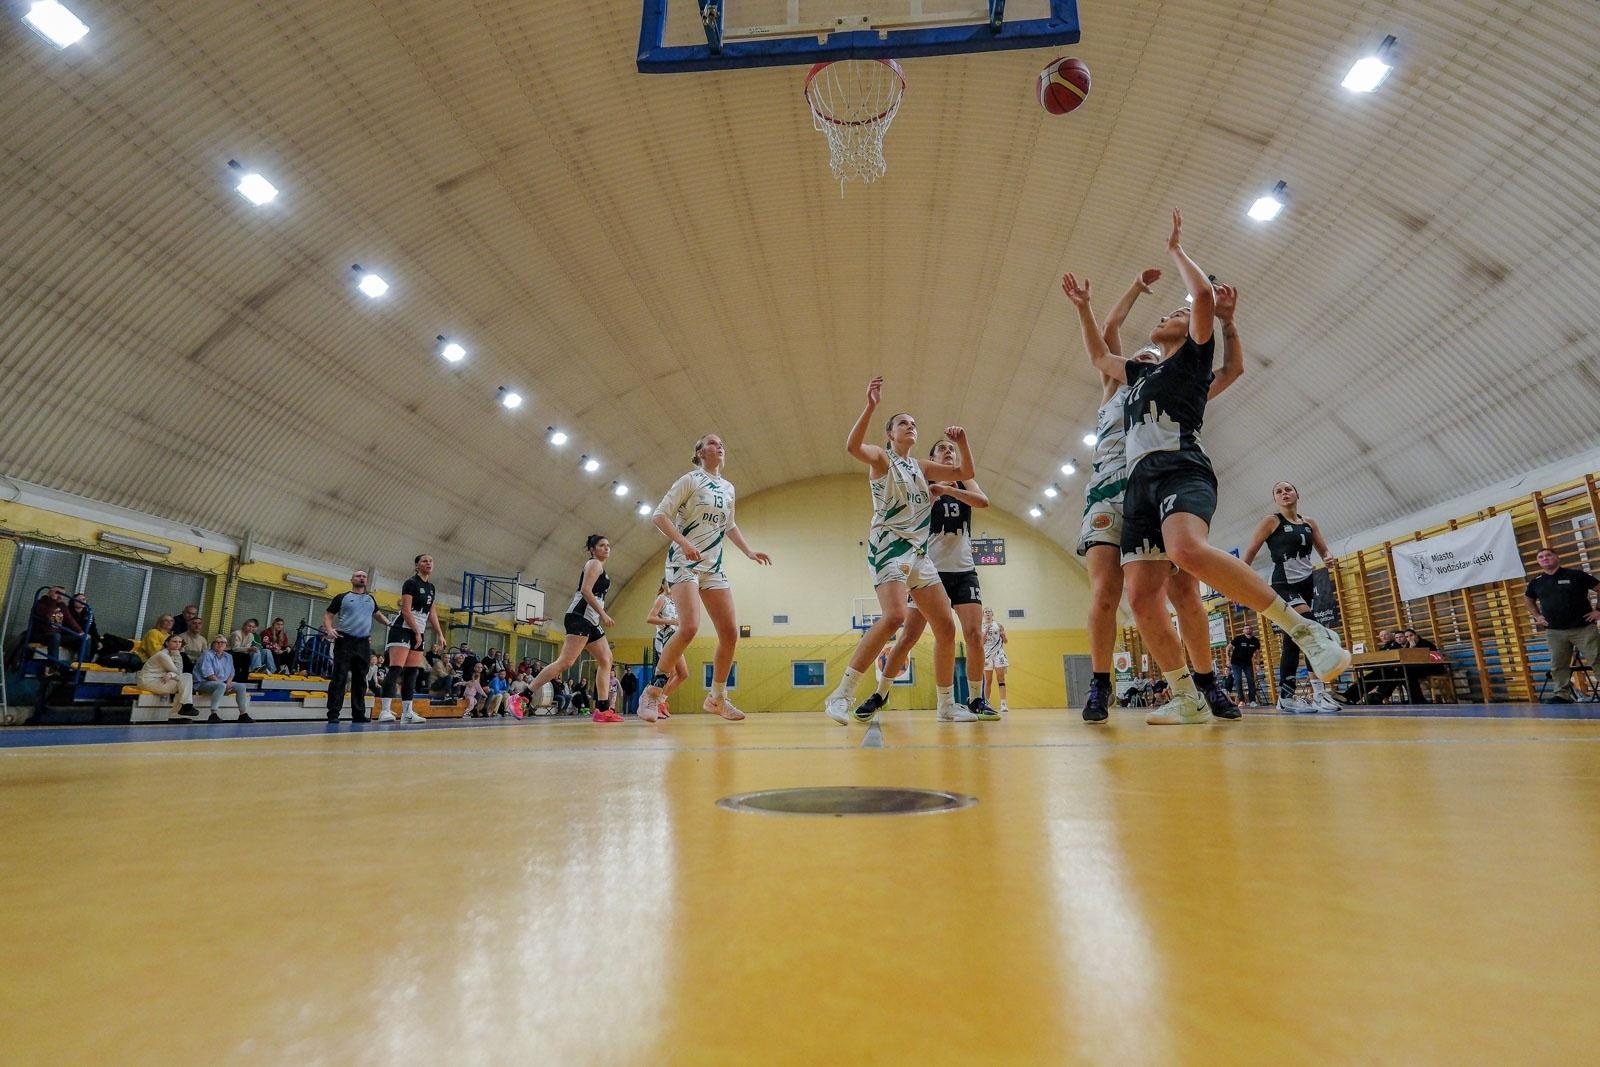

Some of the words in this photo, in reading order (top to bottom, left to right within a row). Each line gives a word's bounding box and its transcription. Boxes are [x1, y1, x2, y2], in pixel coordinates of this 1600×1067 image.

[713, 494, 724, 509] 13
[1159, 493, 1177, 521] 17
[702, 512, 719, 523] DIG
[943, 502, 960, 518] 13
[1430, 551, 1454, 563] Miasto
